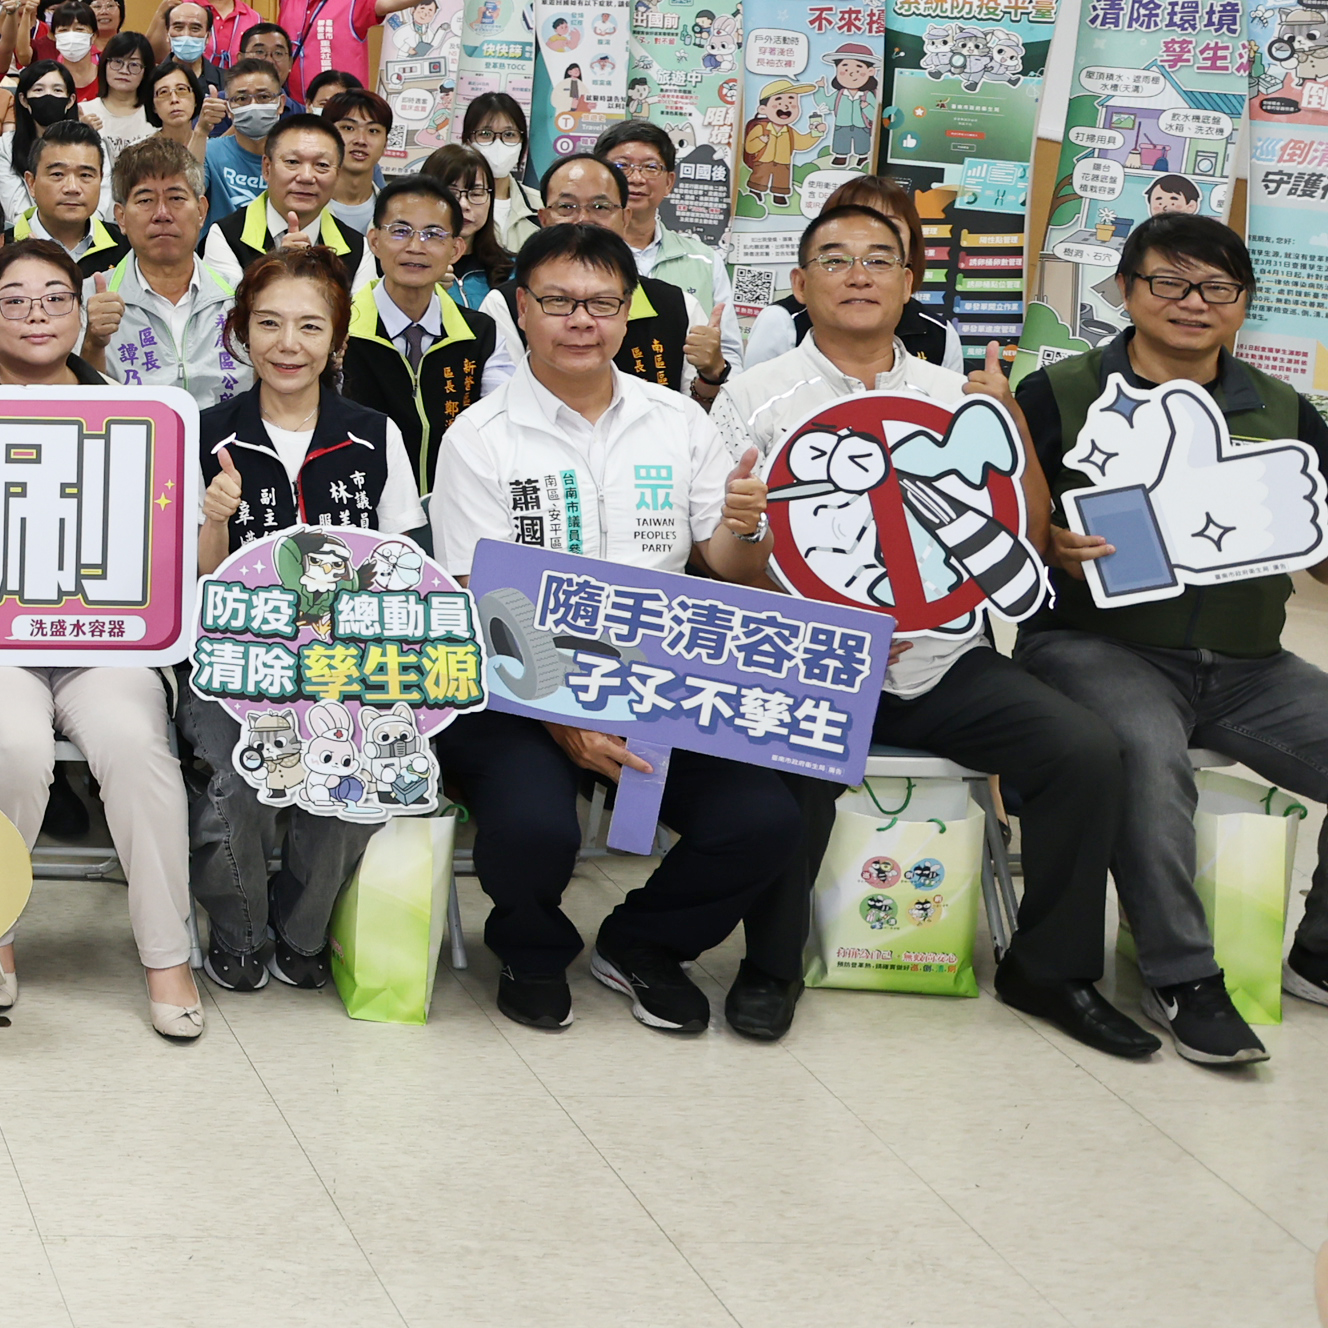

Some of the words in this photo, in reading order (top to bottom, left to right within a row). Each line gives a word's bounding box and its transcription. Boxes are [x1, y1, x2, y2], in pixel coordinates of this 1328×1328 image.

[632, 12, 680, 30] 出國前
[482, 43, 523, 58] 快快篩
[709, 125, 733, 144] 境
[1074, 132, 1117, 145] 打掃用具
[679, 163, 727, 181] 回國後
[138, 327, 162, 372] 區長
[630, 347, 647, 373] 區長
[349, 470, 373, 529] 市議員
[634, 518, 675, 527] TAIWAN
[633, 530, 677, 540] PEOPLE'S
[641, 543, 673, 553] PARTY
[204, 584, 295, 634] 防疫
[337, 593, 473, 639] 總動員
[29, 618, 126, 638] 洗盛水容器
[536, 571, 871, 692] 隨手清容器
[196, 640, 481, 702] 清除孳生源
